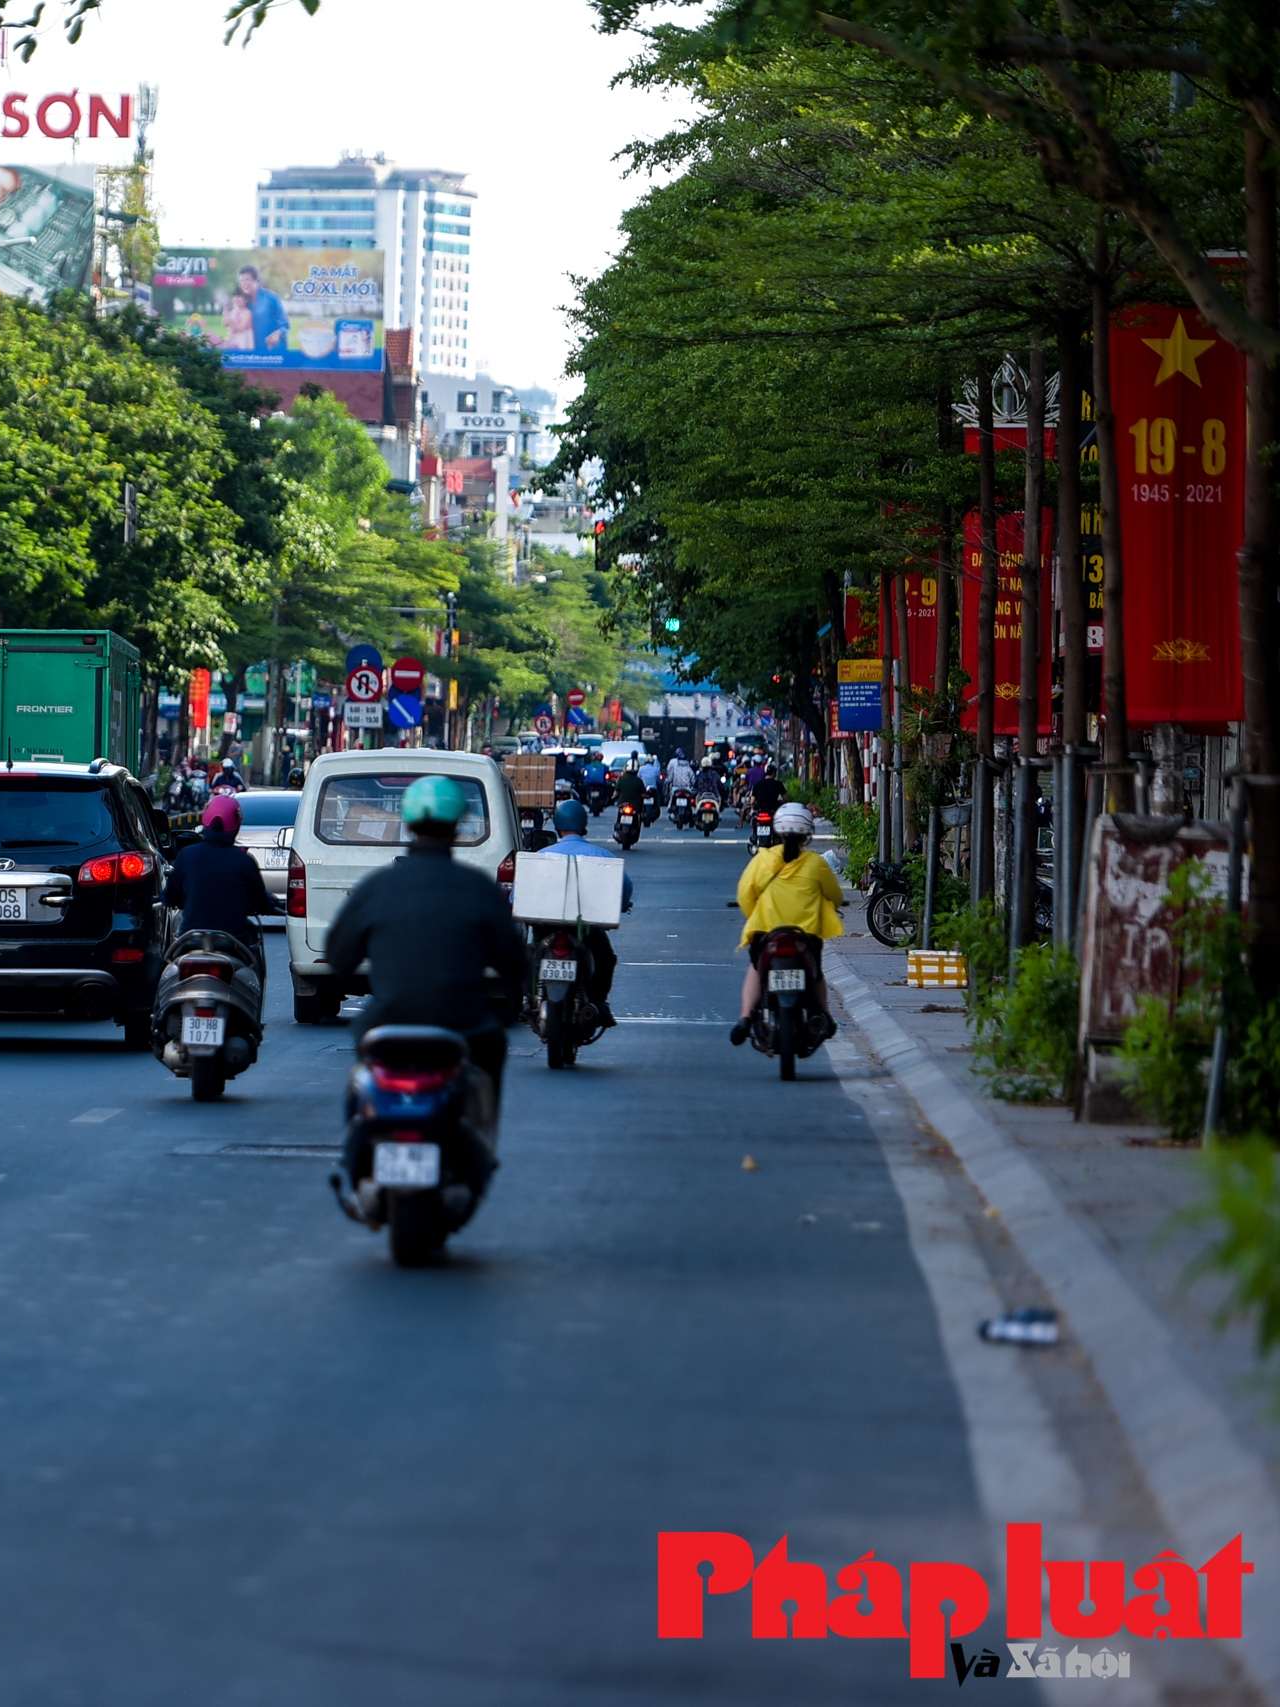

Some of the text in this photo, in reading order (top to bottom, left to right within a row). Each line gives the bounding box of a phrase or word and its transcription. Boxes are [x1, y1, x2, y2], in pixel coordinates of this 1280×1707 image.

[1, 87, 132, 139] SƠN
[311, 266, 329, 277] RA
[321, 281, 339, 295] XL
[343, 278, 377, 296] MỚI
[461, 416, 505, 427] TOTO
[1131, 484, 1170, 501] 1945
[1186, 484, 1222, 502] 2021
[16, 705, 73, 714] FRONTIER
[546, 961, 572, 969] 29-K1
[543, 969, 574, 979] 030.00
[189, 1018, 219, 1030] 30-H8
[189, 1031, 217, 1043] 1071
